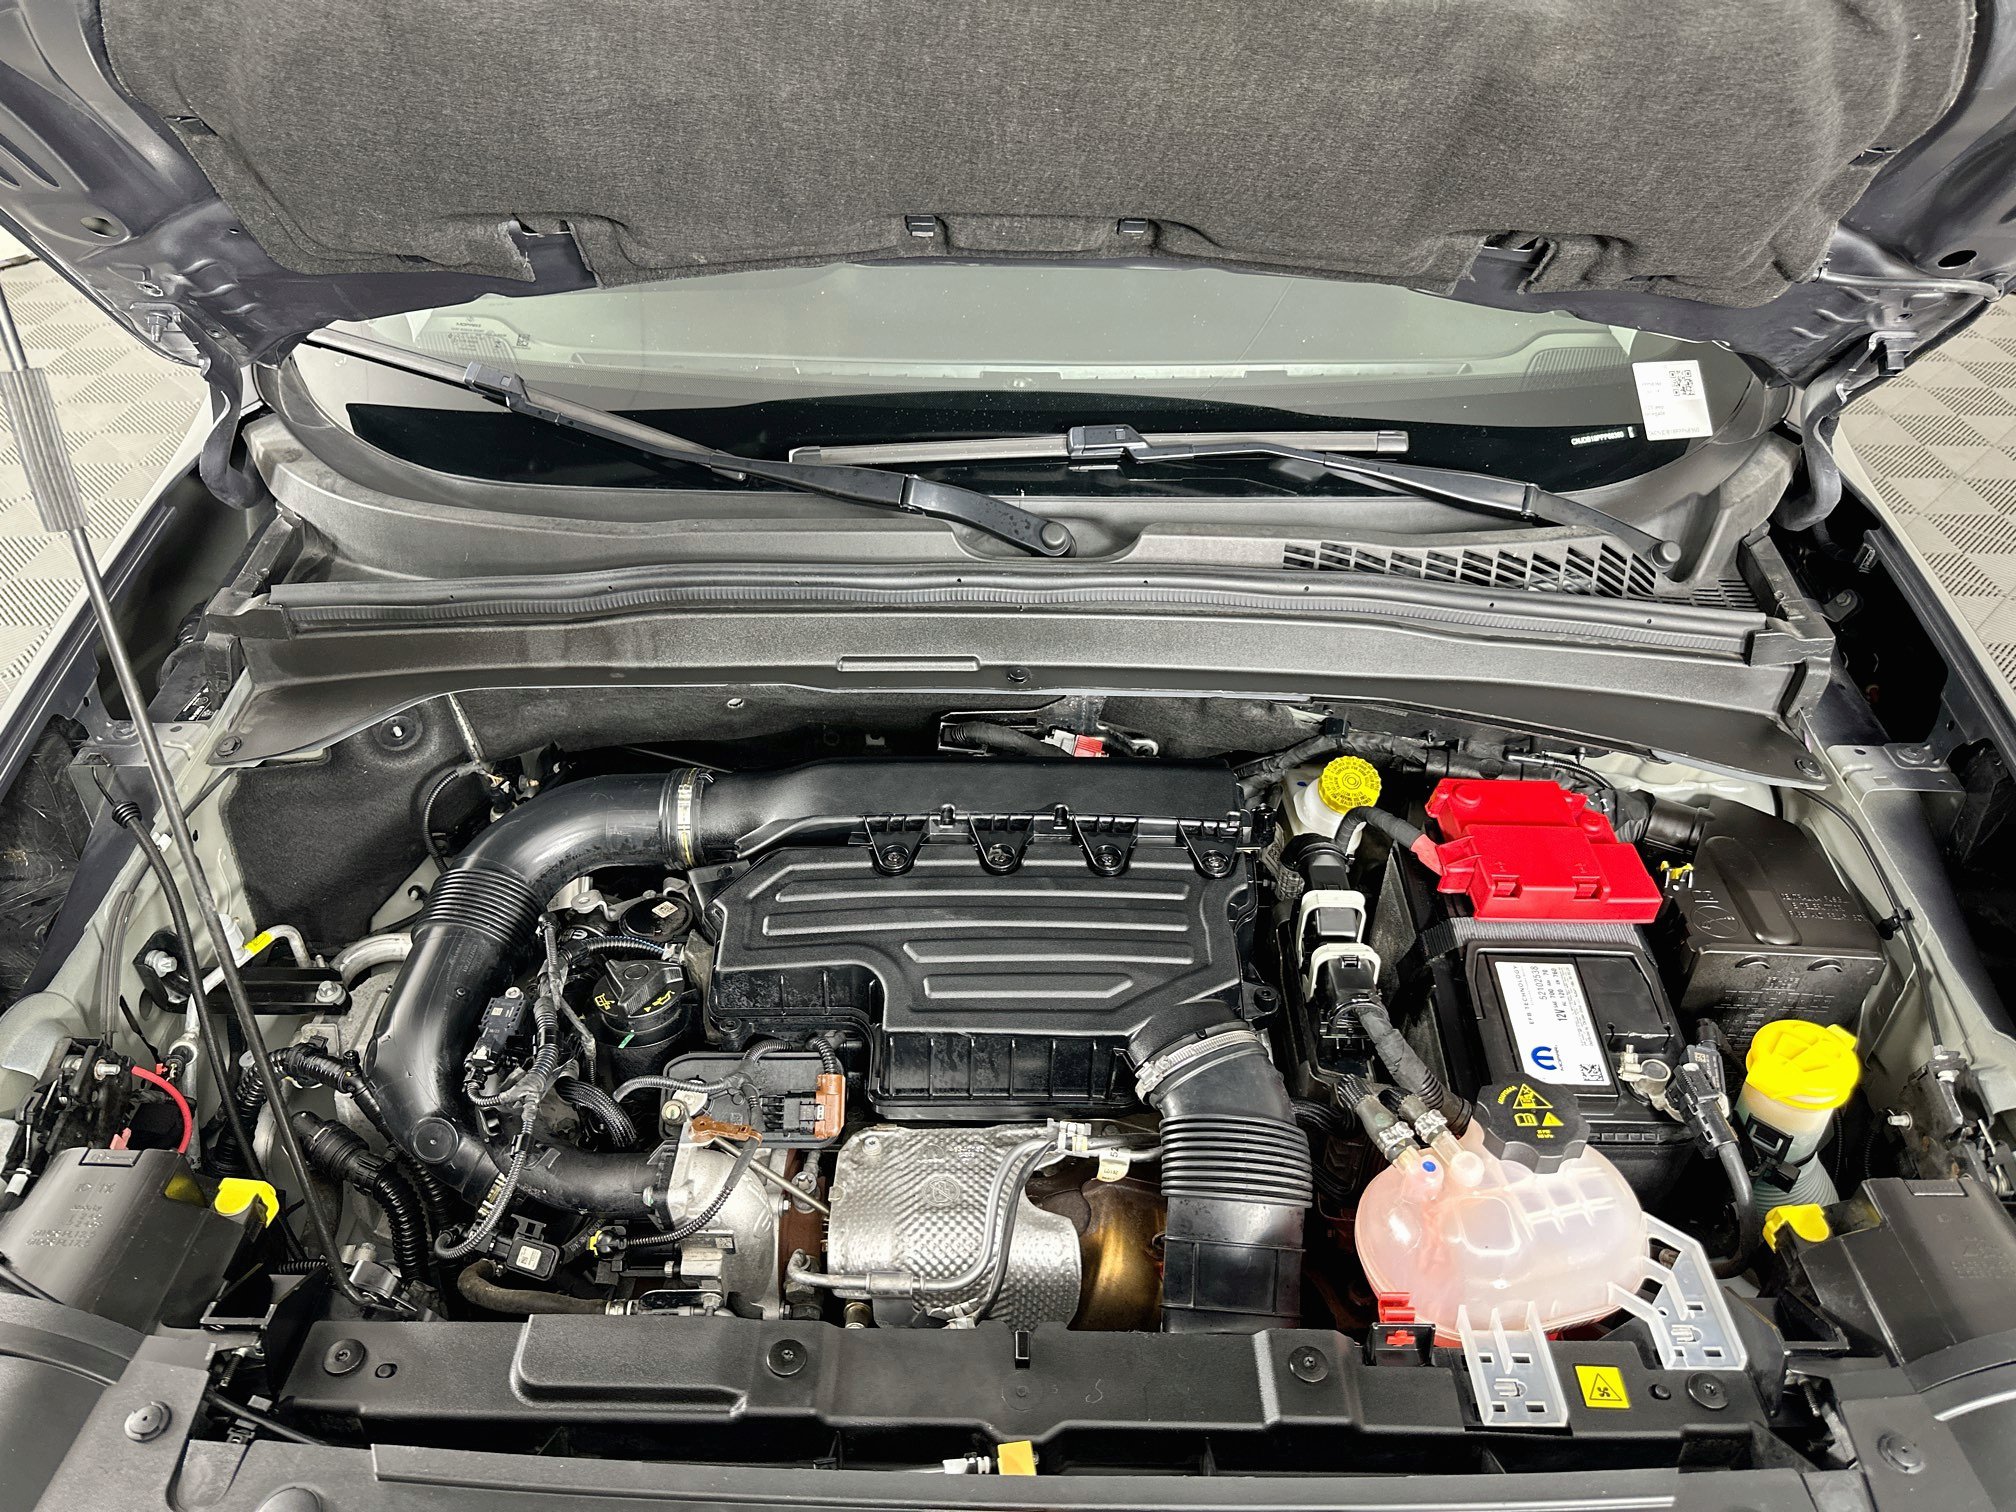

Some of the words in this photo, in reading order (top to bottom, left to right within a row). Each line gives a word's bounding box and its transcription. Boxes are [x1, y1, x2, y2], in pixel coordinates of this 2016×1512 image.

[1513, 965, 1530, 1010] TECHNOLOGY
[1530, 965, 1547, 1001] 52102538
[1526, 1012, 1535, 1025] EFB
[1554, 1009, 1568, 1021] 12V
